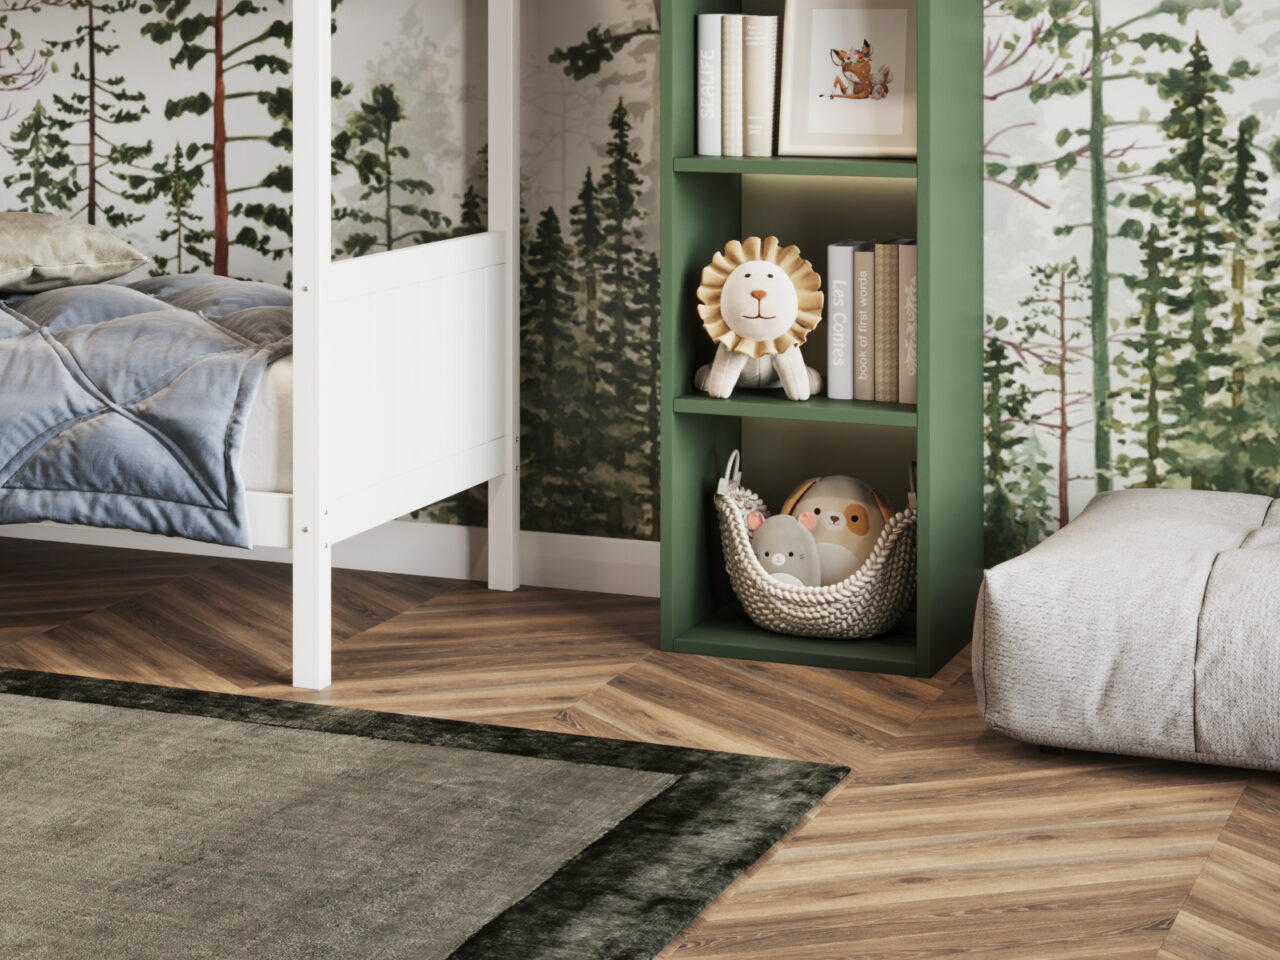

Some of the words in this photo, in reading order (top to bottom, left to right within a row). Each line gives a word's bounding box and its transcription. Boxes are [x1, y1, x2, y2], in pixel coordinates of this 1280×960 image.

[700, 48, 714, 119] SEALIFE
[832, 280, 847, 307] Les
[858, 271, 868, 307] words
[858, 310, 868, 332] first
[832, 312, 847, 366] Contes
[858, 335, 868, 348] of
[858, 350, 868, 380] book
